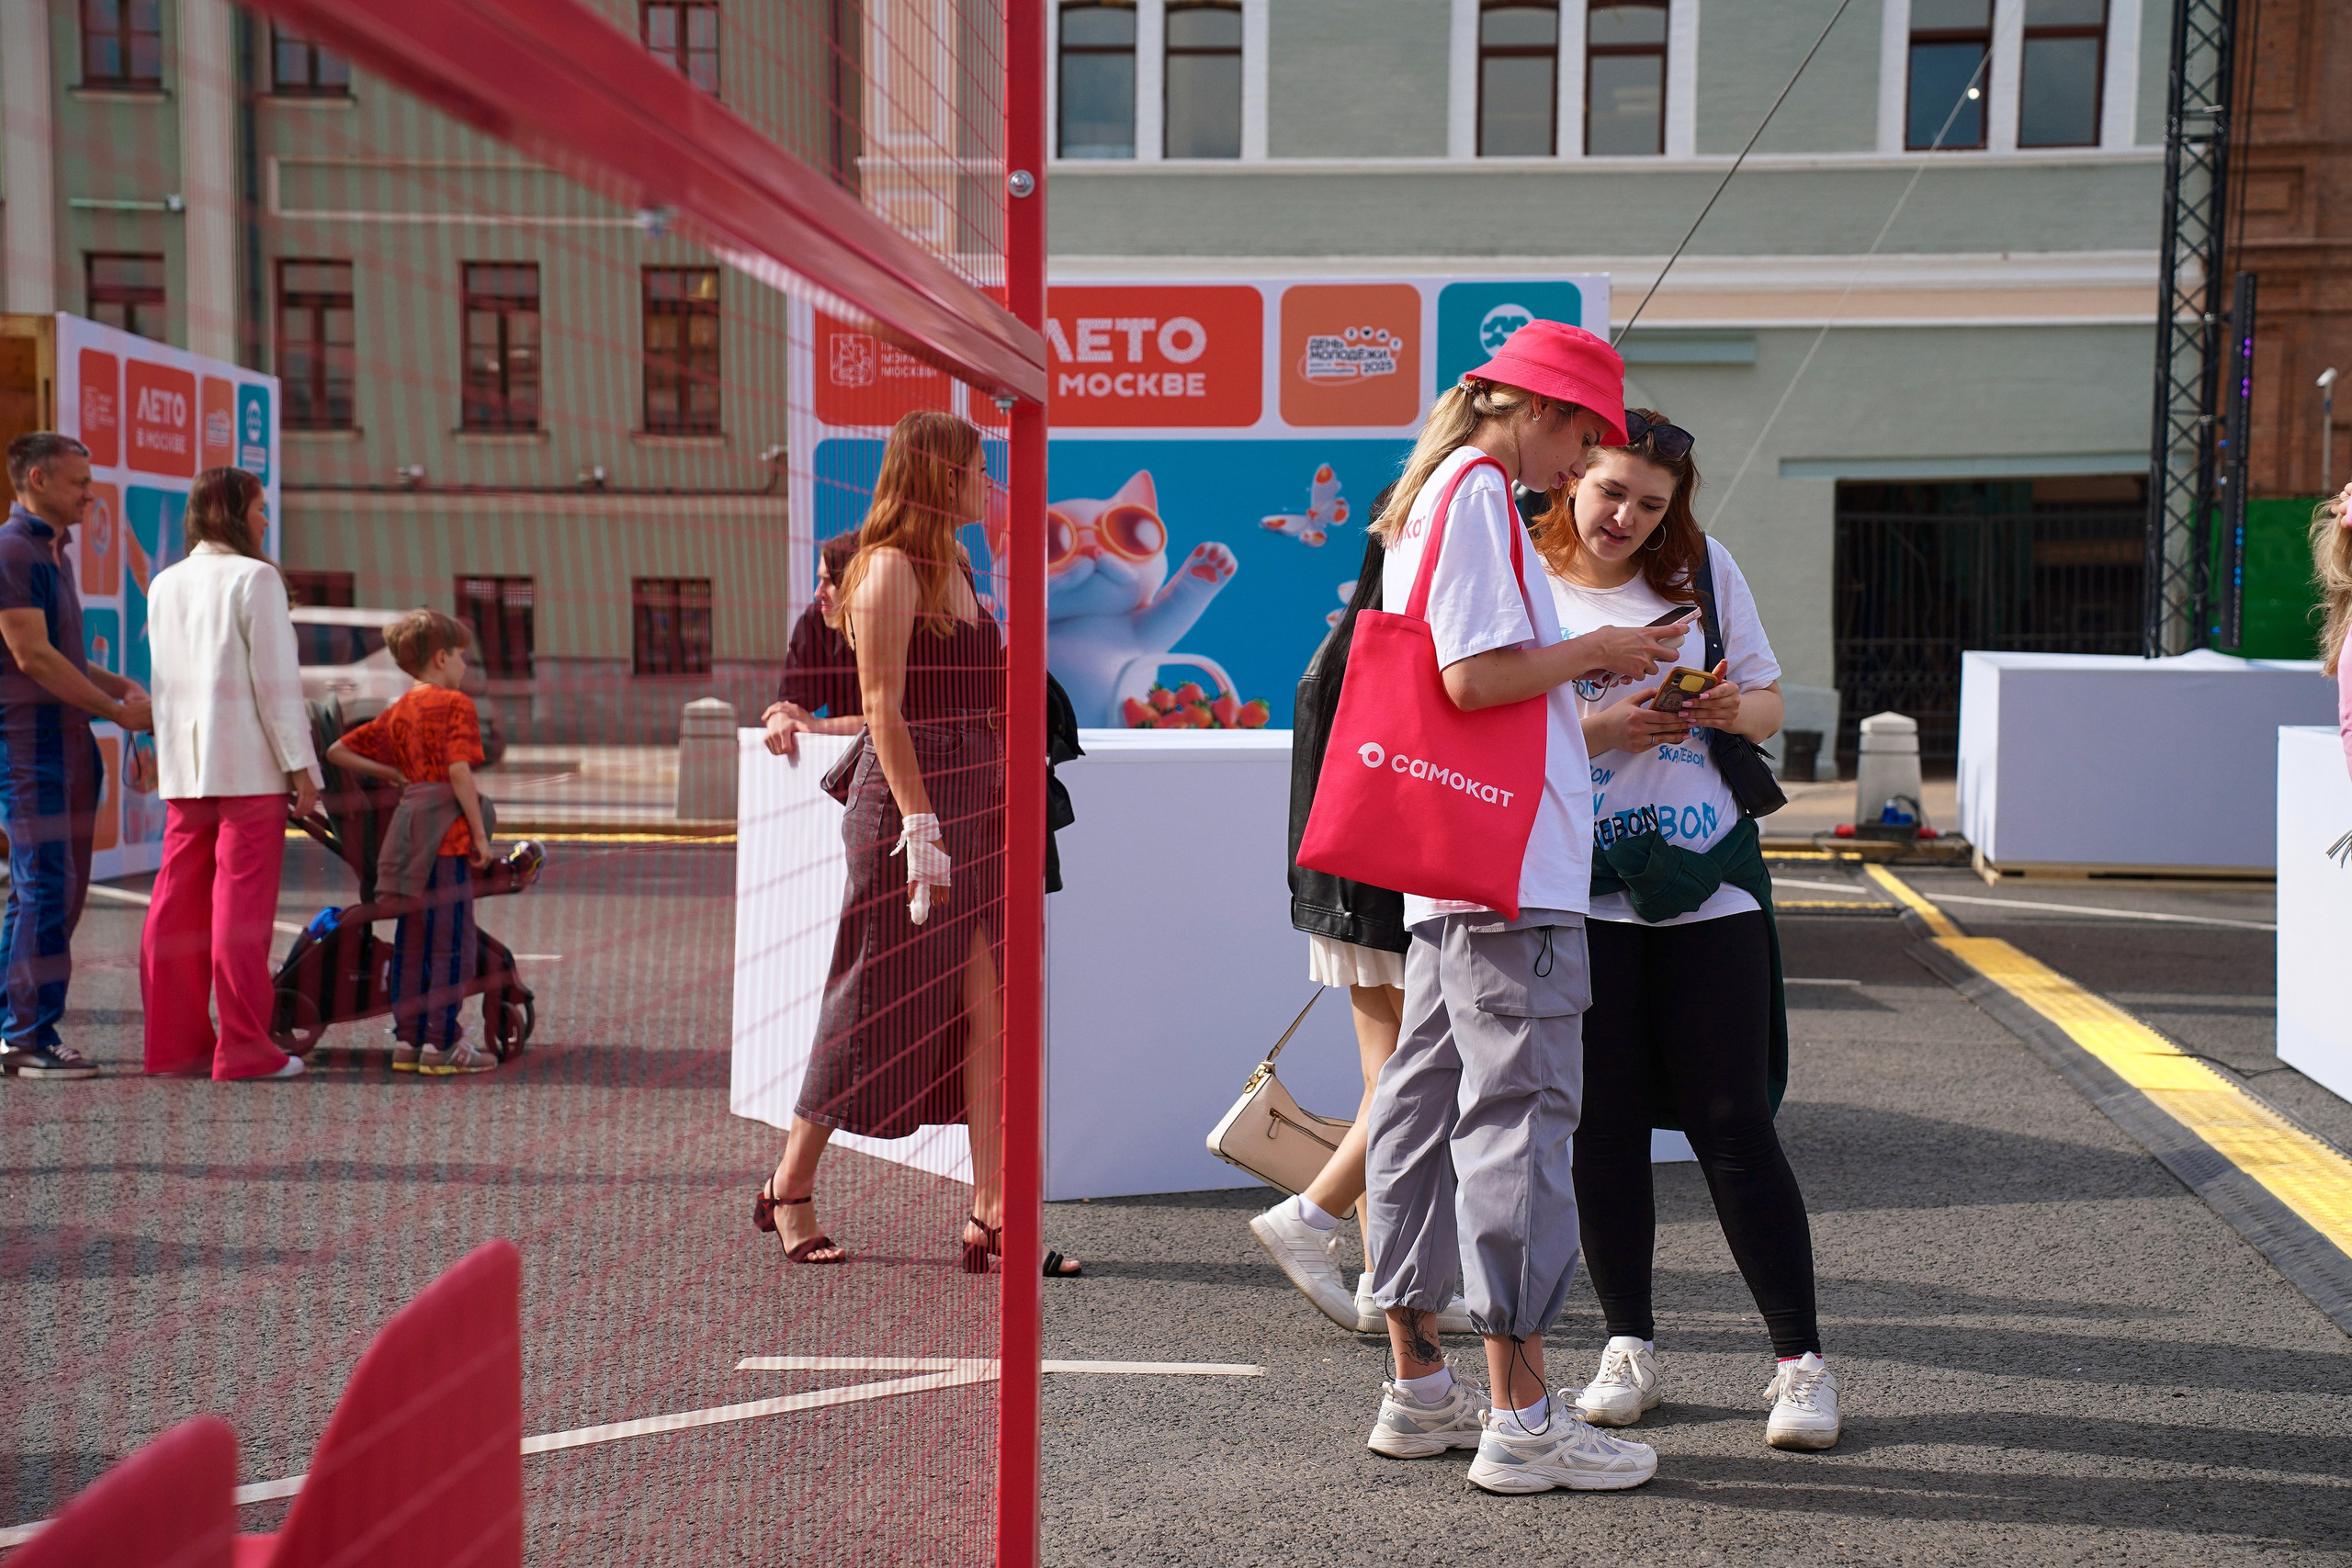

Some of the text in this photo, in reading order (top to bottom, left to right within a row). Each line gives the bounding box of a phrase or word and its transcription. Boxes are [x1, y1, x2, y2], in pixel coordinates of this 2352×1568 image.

[1310, 339, 1344, 349] ДЕНЬ
[1363, 361, 1393, 373] 2025
[1057, 372, 1206, 397] МОСКВЕ
[137, 386, 187, 427] ЛЕТО
[1658, 745, 1705, 769] SKATEBON
